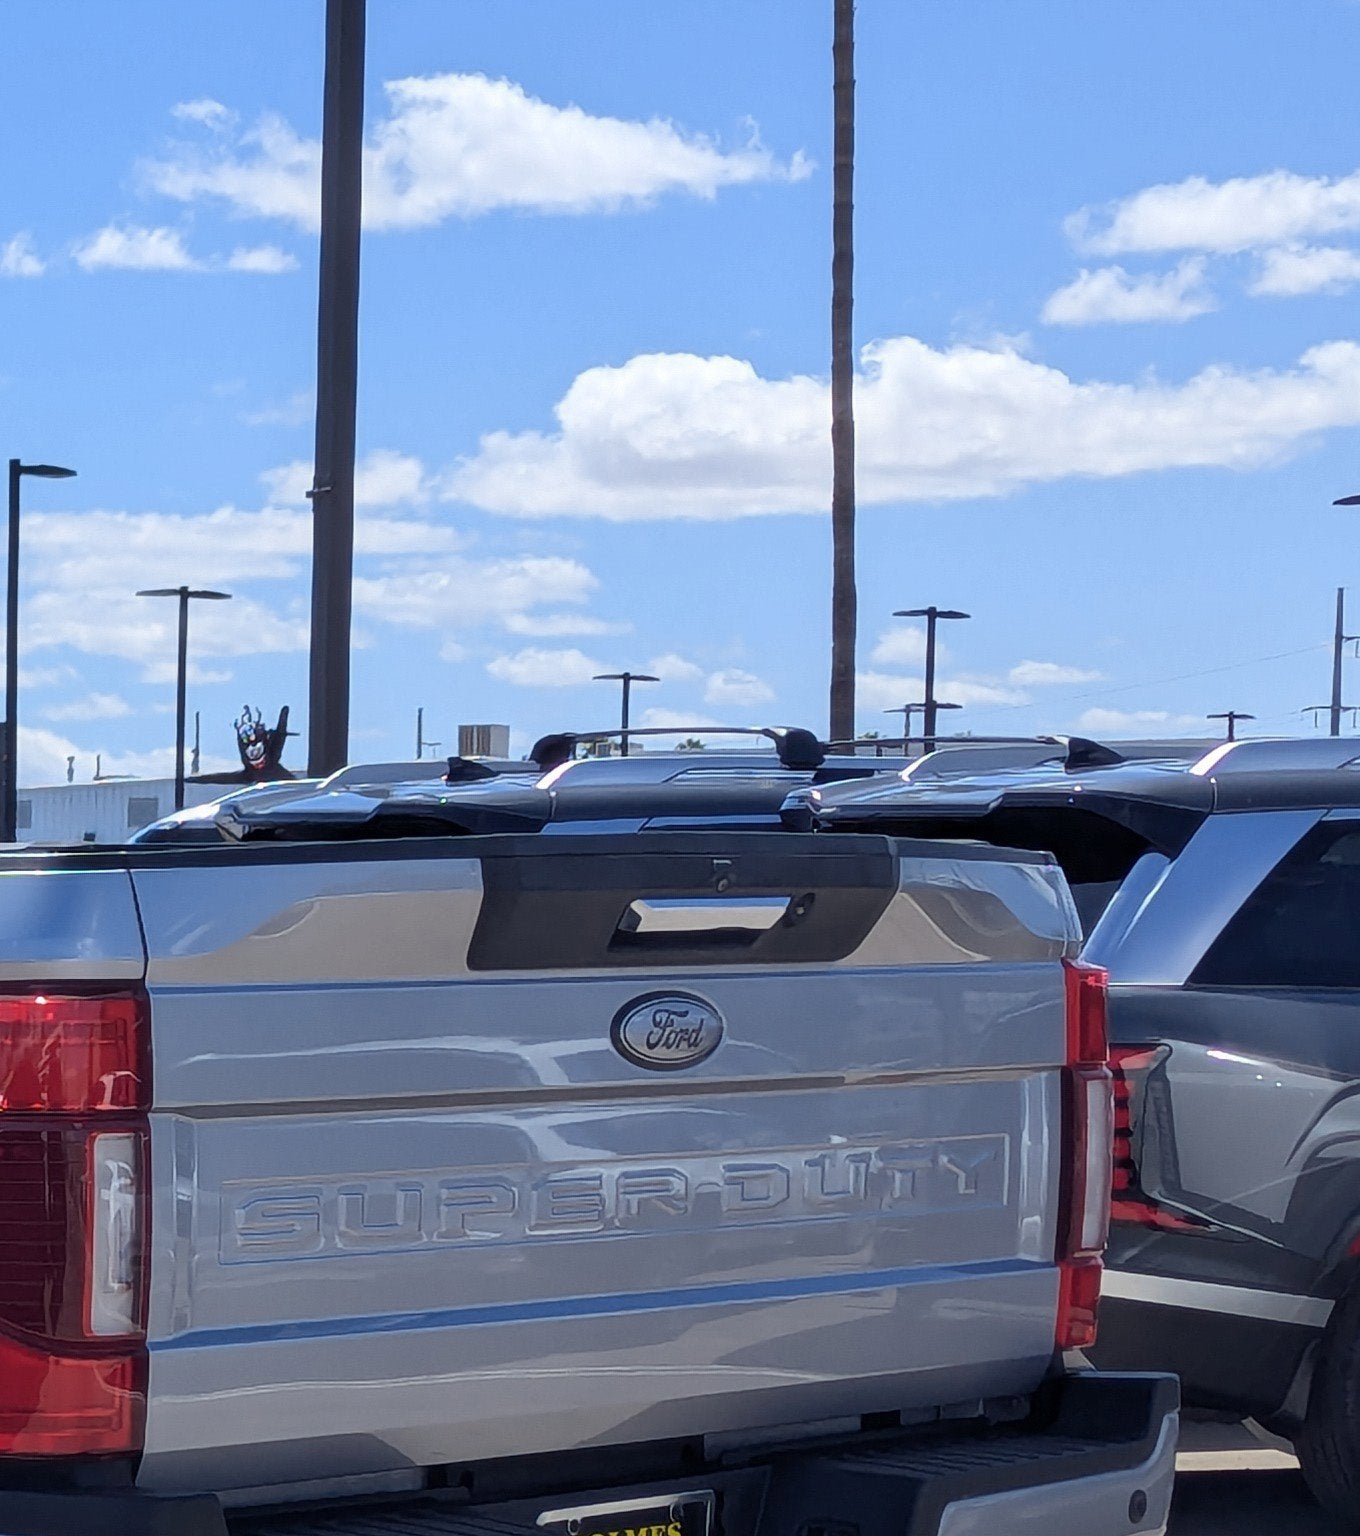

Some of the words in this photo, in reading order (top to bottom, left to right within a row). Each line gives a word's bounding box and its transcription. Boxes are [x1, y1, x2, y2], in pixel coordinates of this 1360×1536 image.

[645, 1008, 704, 1051] Ford
[234, 1165, 689, 1252] SUPER
[720, 1142, 1000, 1214] DUTY
